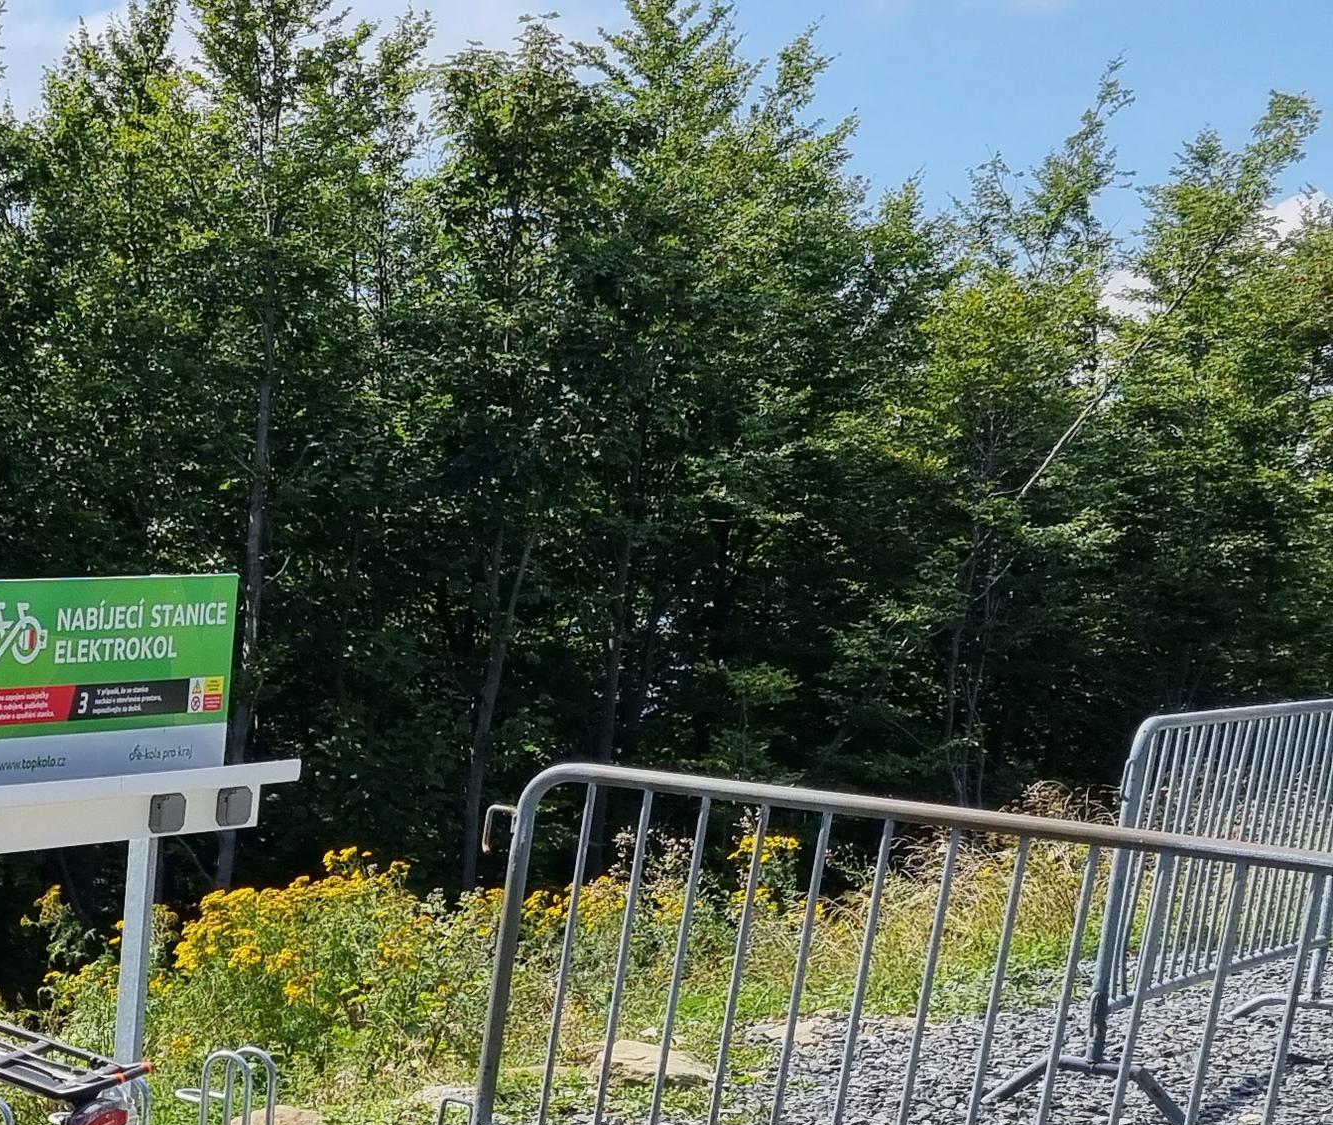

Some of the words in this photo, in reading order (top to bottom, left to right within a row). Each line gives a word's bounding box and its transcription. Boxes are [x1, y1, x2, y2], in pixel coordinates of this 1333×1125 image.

[57, 597, 145, 631] NABÍJECÍ
[150, 602, 228, 628] STANICE
[54, 636, 178, 664] ELEKTROKOL
[77, 692, 89, 714] 3
[162, 749, 176, 761] pro
[178, 744, 193, 759] kraj
